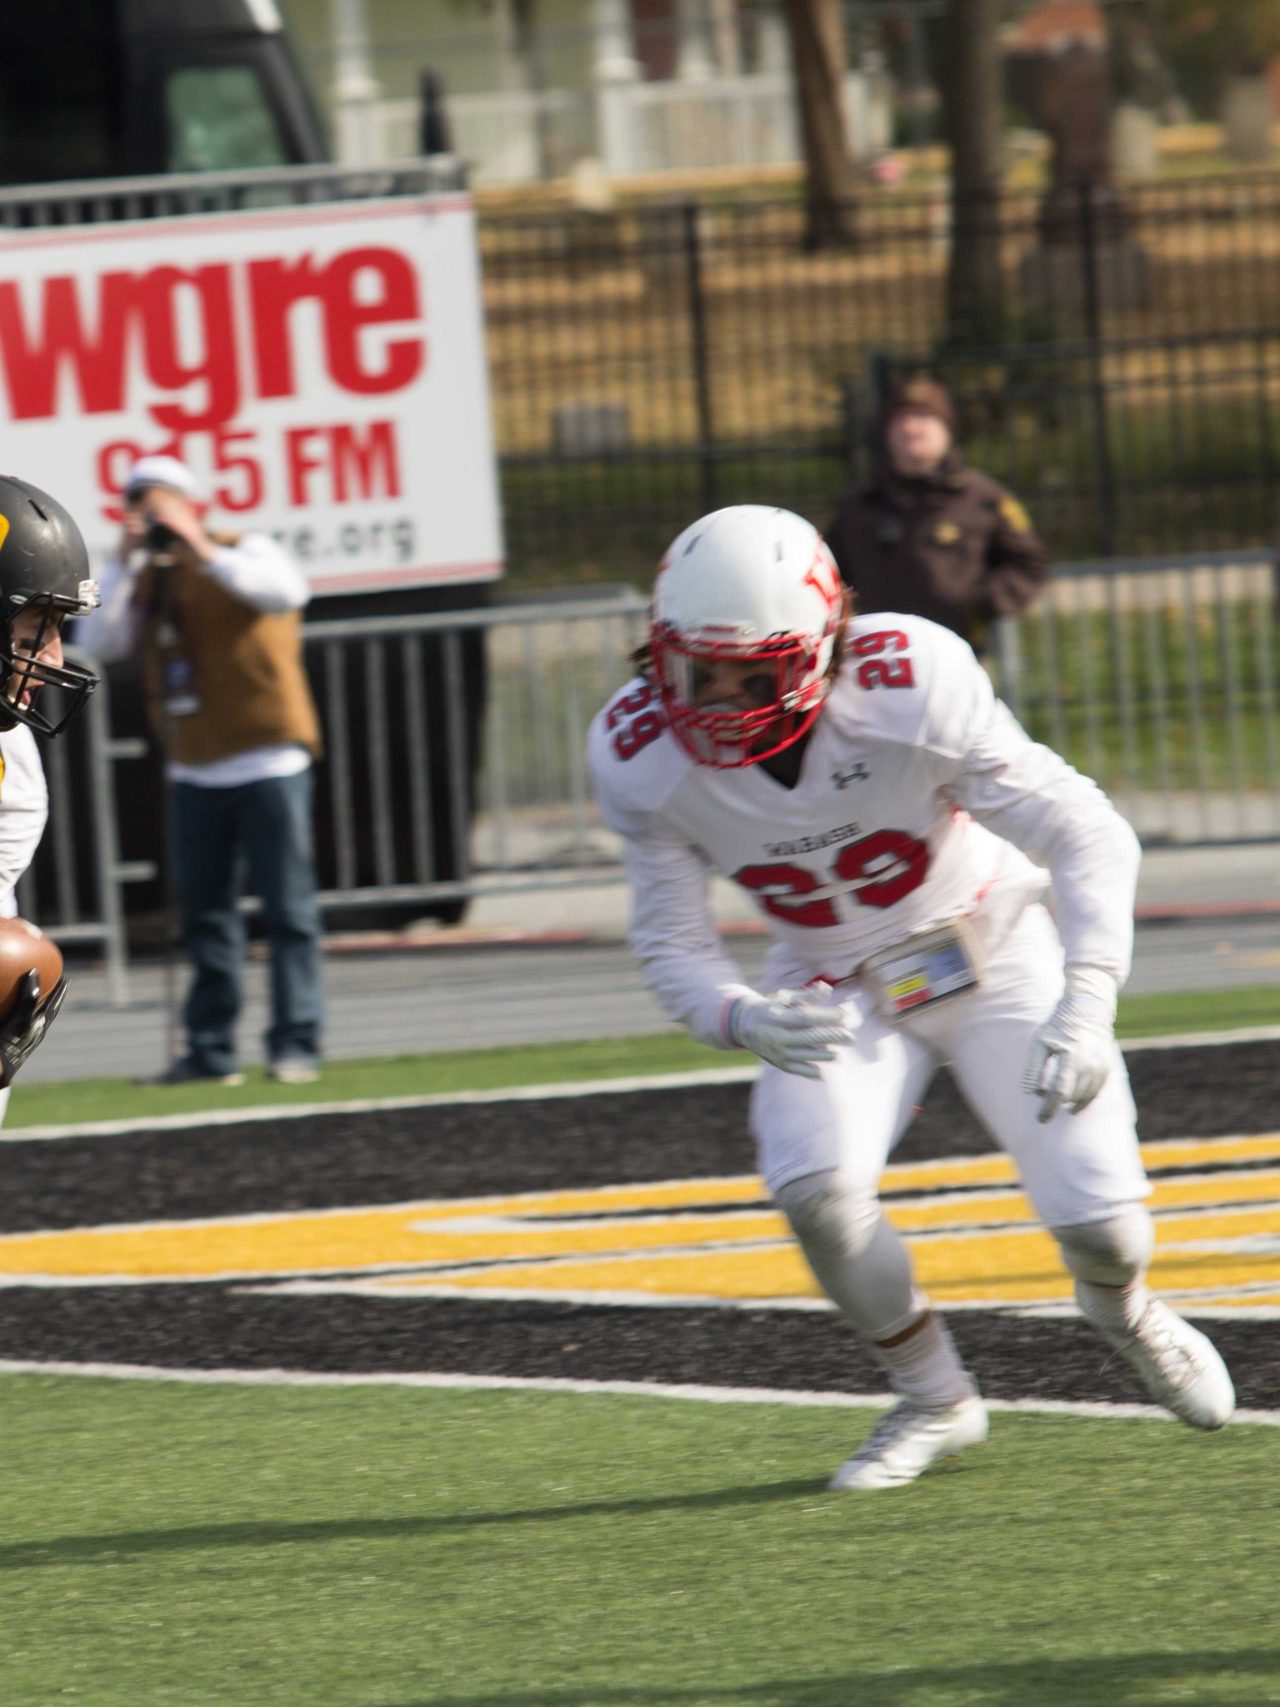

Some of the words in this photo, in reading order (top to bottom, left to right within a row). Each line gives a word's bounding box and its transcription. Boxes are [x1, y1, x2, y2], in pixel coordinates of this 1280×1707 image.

[286, 420, 401, 508] FM
[852, 629, 917, 690] 29
[607, 685, 662, 762] 29
[733, 828, 932, 929] 29
